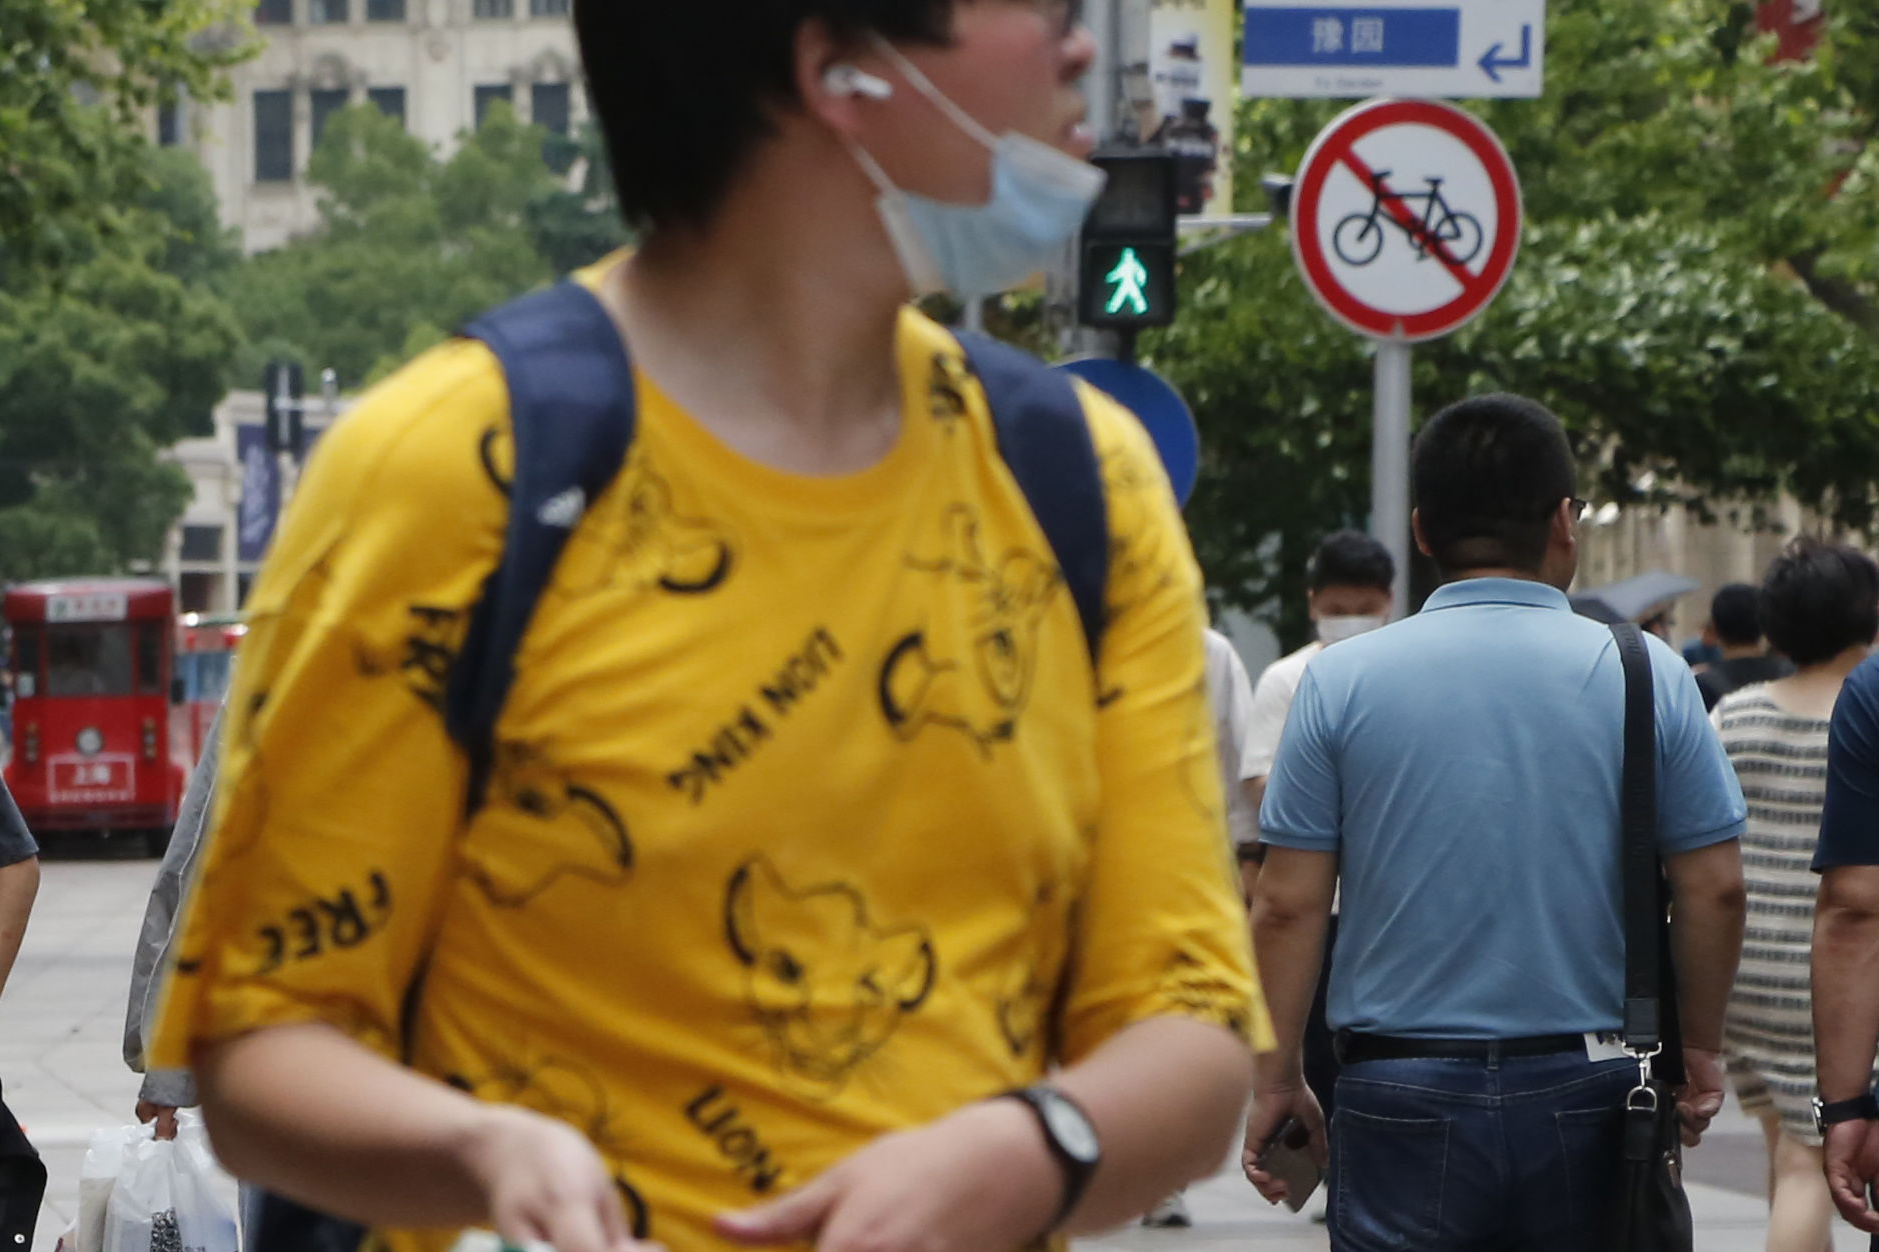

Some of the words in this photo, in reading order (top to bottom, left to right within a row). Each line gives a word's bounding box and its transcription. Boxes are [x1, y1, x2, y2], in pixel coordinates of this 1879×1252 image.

[759, 620, 842, 716] LION
[666, 704, 773, 806] KING
[255, 868, 394, 976] FREE
